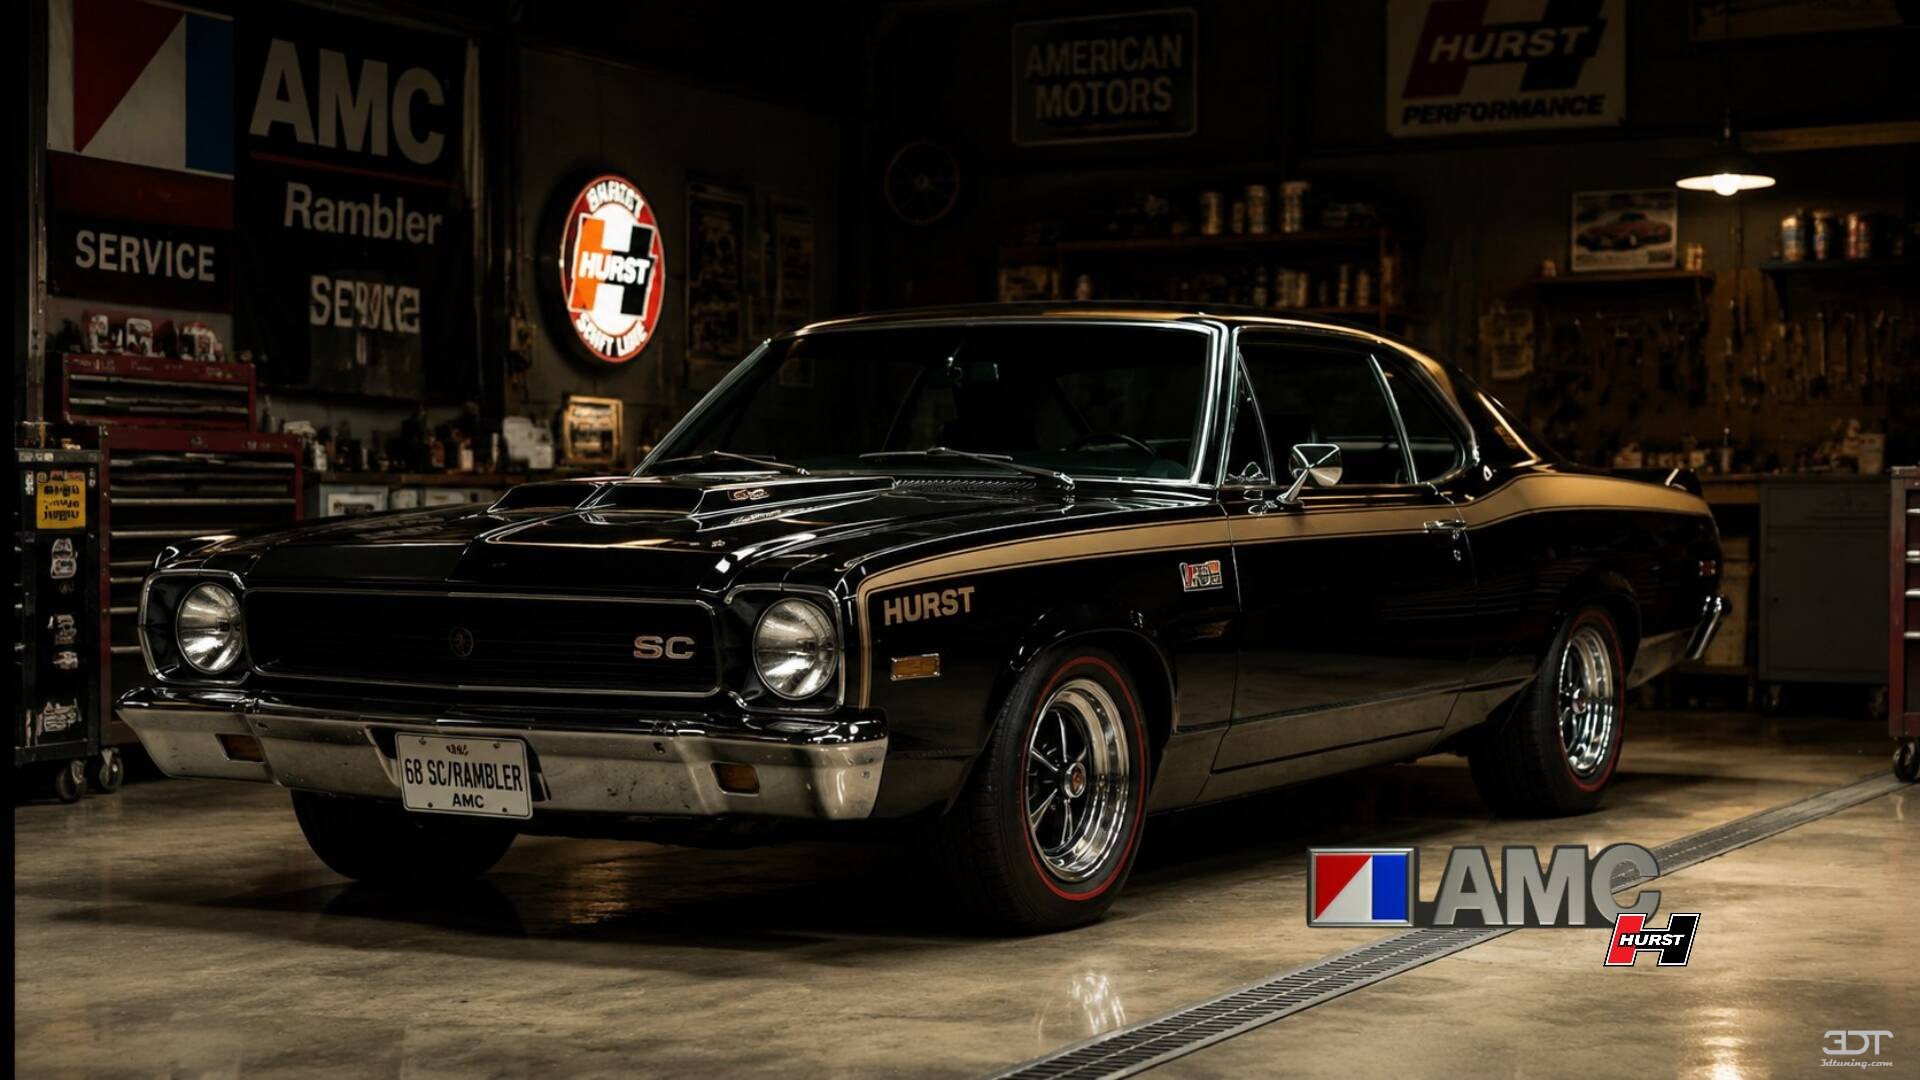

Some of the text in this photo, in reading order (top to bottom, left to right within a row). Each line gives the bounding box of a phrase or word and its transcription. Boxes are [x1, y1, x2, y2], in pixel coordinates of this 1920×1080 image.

[1023, 32, 1184, 79] AMERICAN
[1428, 24, 1590, 63] HURST
[248, 37, 448, 165] AMC
[1035, 76, 1174, 120] MOTORS
[1402, 94, 1605, 125] PERFORMANCE
[283, 181, 443, 246] Rambler
[75, 229, 216, 283] SERVICE
[578, 250, 650, 285] HURST
[883, 586, 975, 627] HURST
[633, 635, 696, 660] SC
[427, 760, 522, 791] SC/RAMBLER
[452, 793, 484, 809] AMC
